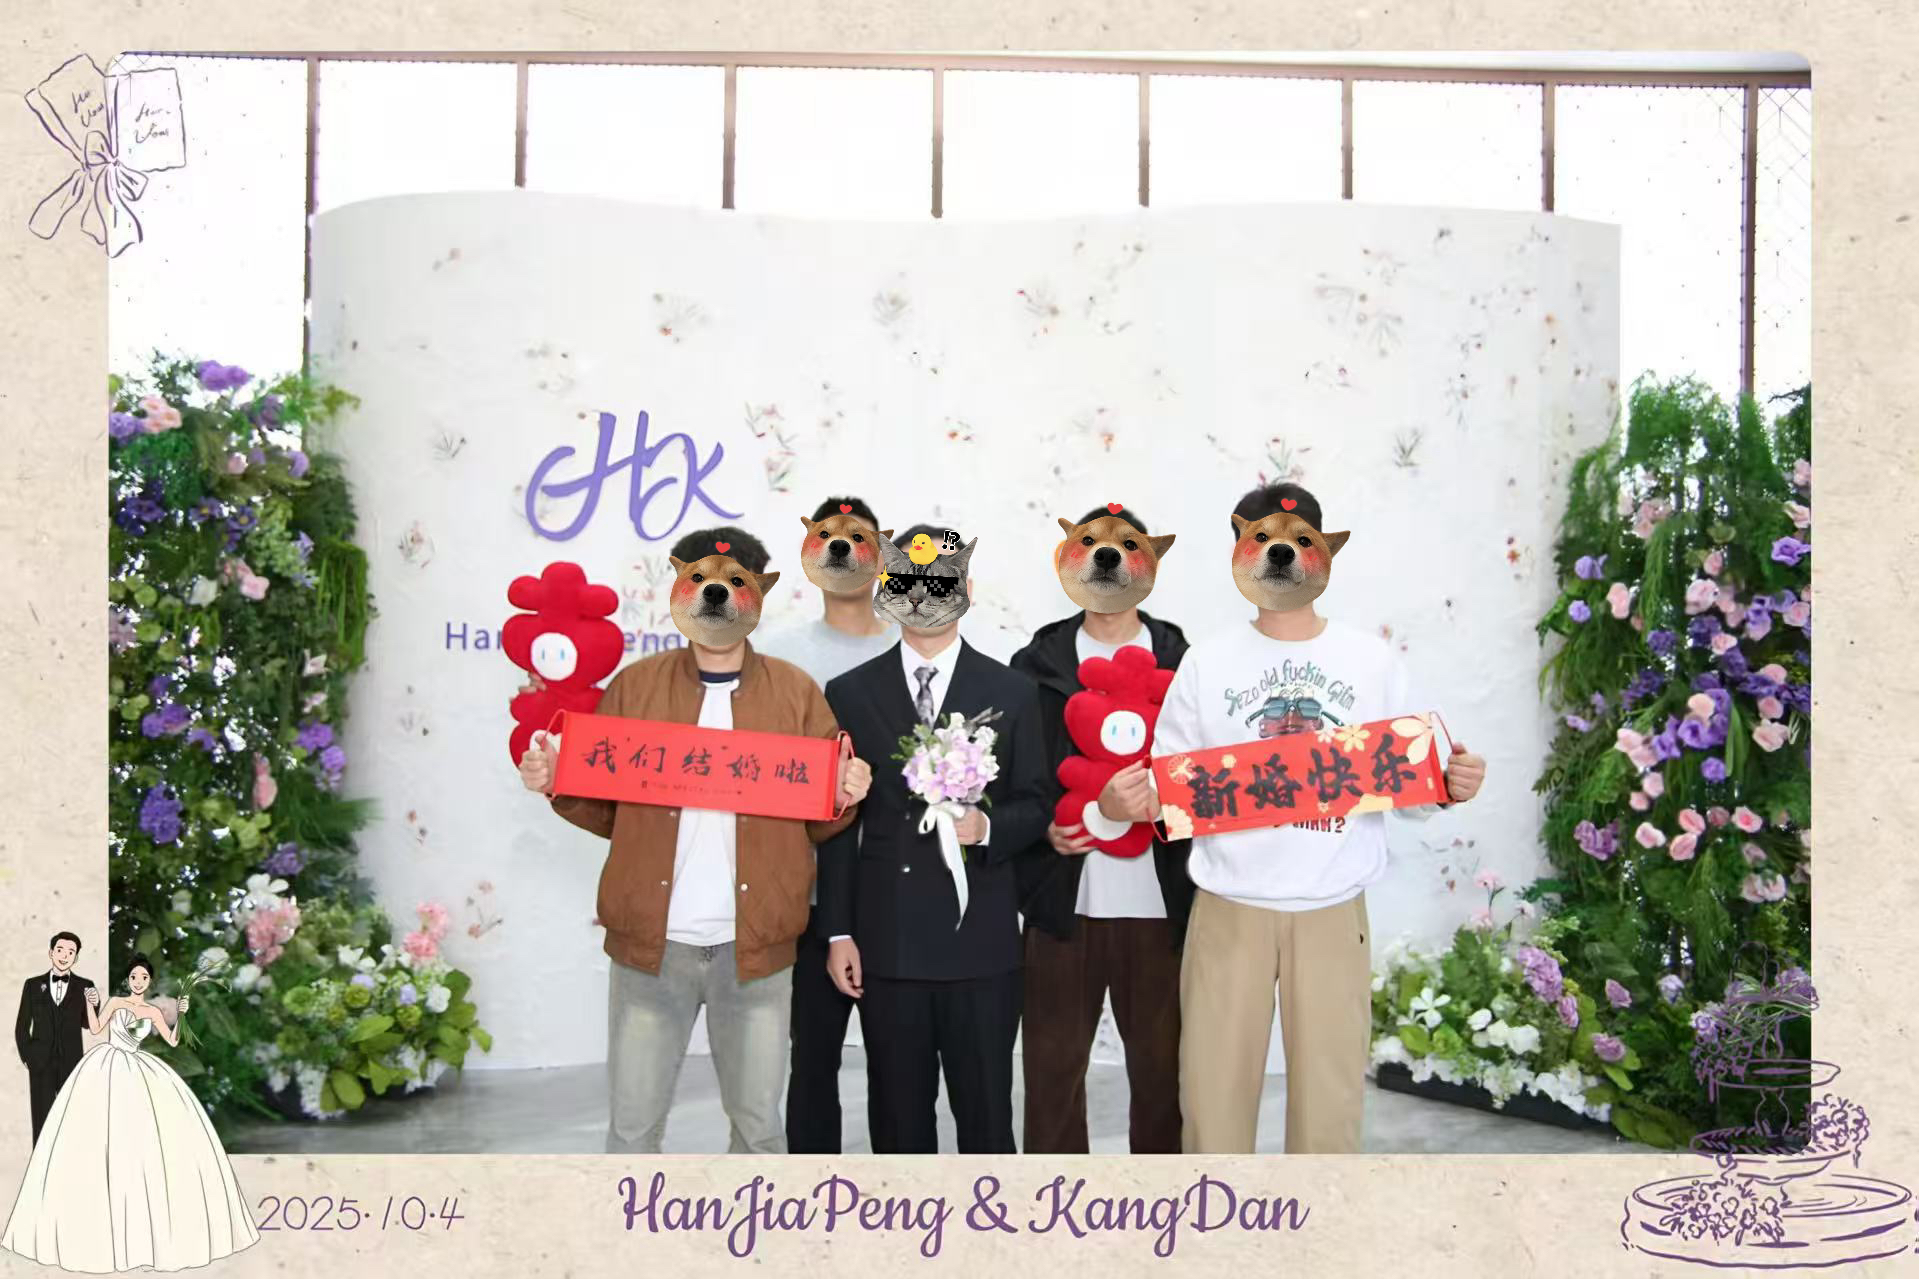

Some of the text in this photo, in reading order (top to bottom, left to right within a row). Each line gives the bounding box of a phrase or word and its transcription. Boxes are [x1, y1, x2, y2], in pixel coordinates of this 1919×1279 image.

[526, 410, 745, 542] HK
[446, 622, 502, 650] Ha
[582, 736, 810, 784] 我们结婚啦
[1187, 733, 1417, 819] 新婚快乐
